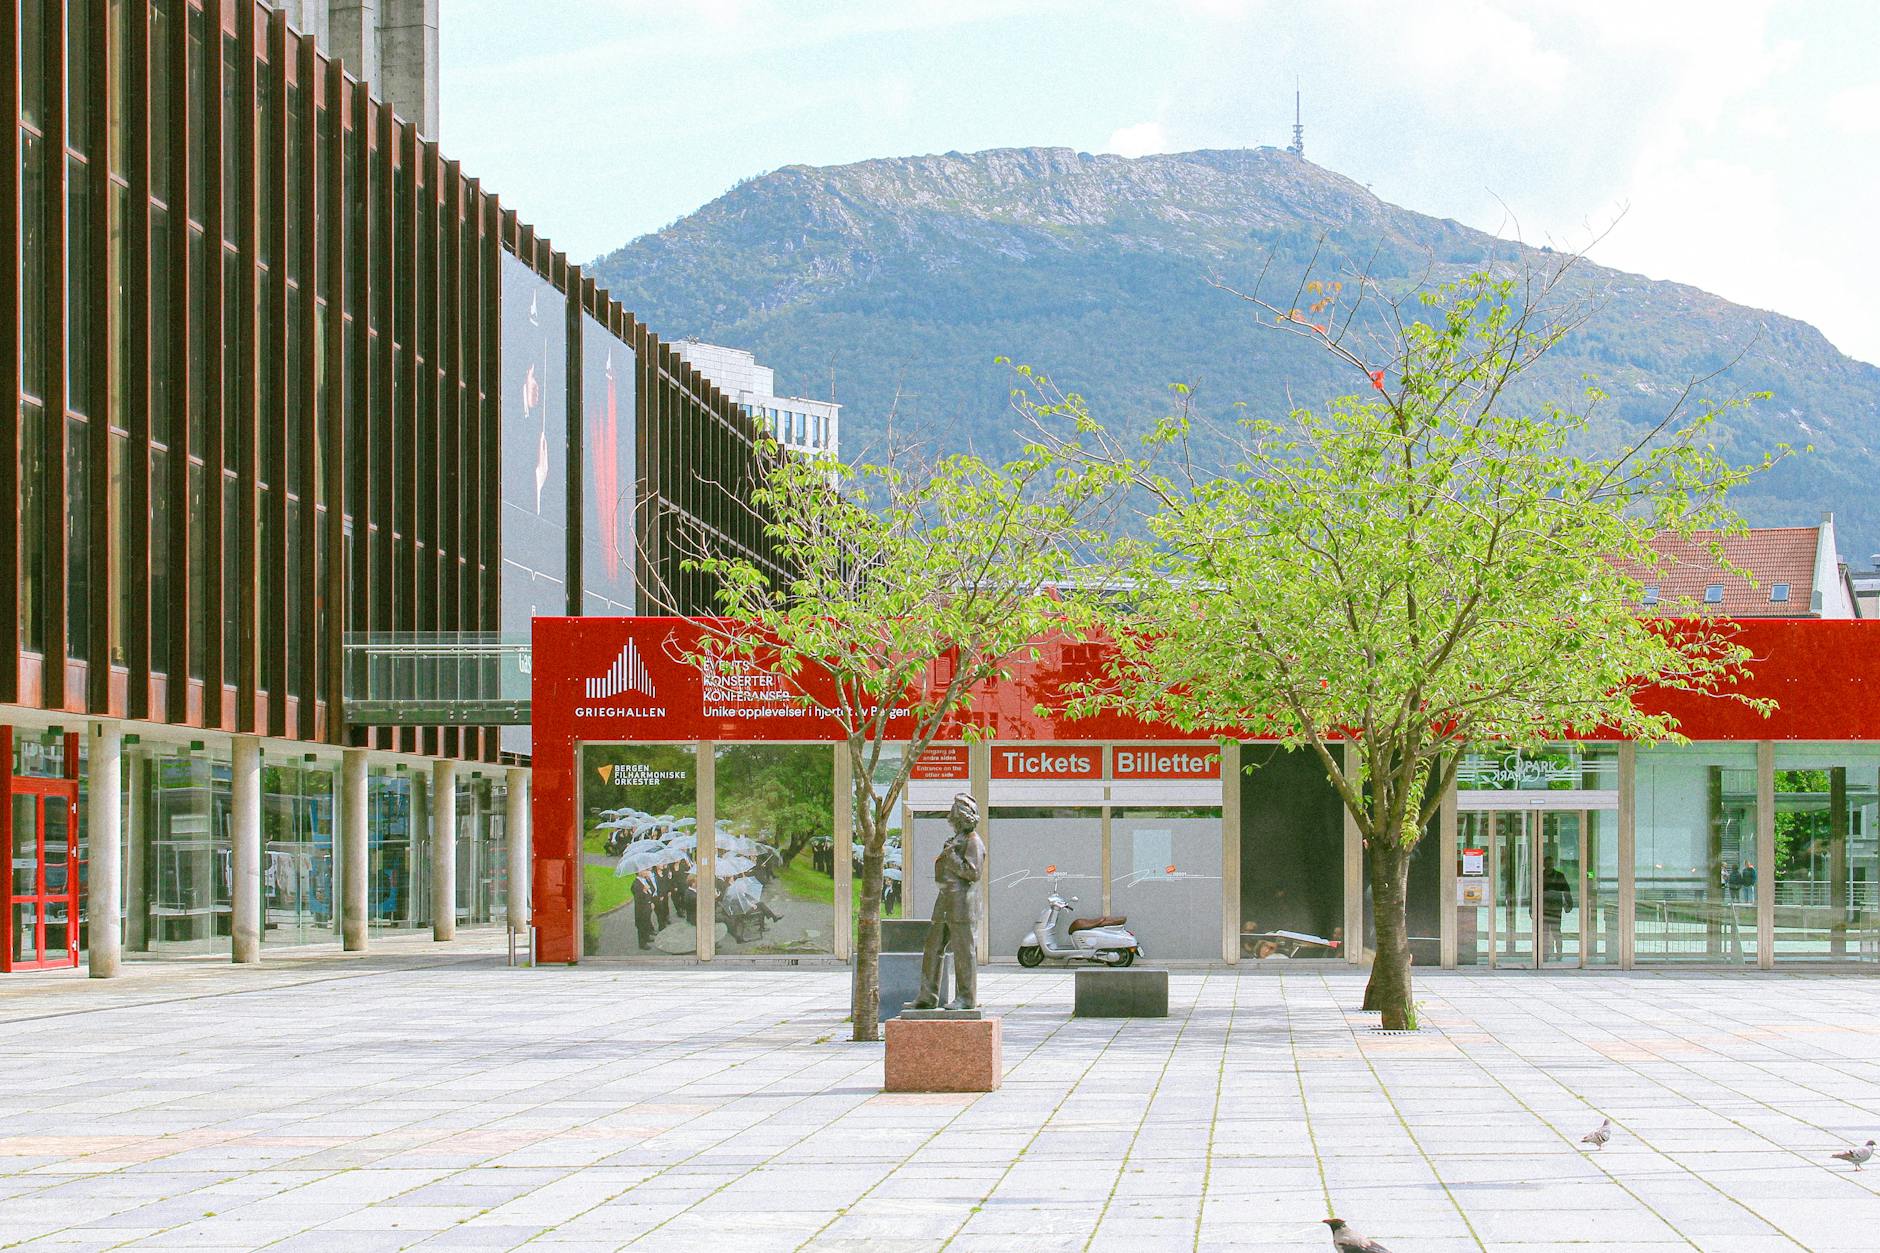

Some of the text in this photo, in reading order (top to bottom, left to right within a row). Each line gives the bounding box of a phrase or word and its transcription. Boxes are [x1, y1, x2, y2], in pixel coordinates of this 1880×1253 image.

[703, 675, 773, 686] KONSERTER
[703, 690, 790, 702] KONFERANSER
[575, 707, 666, 718] GRIEGHALLEN
[703, 706, 736, 717] Unike
[738, 706, 806, 719] opplevelser
[808, 706, 812, 716] i
[855, 708, 868, 716] v
[870, 706, 910, 719] Bgen
[614, 764, 650, 772] BERGEN
[1002, 752, 1091, 773] Tickets
[1117, 752, 1217, 773] Billetter
[614, 771, 686, 779] FILHARMONISKE
